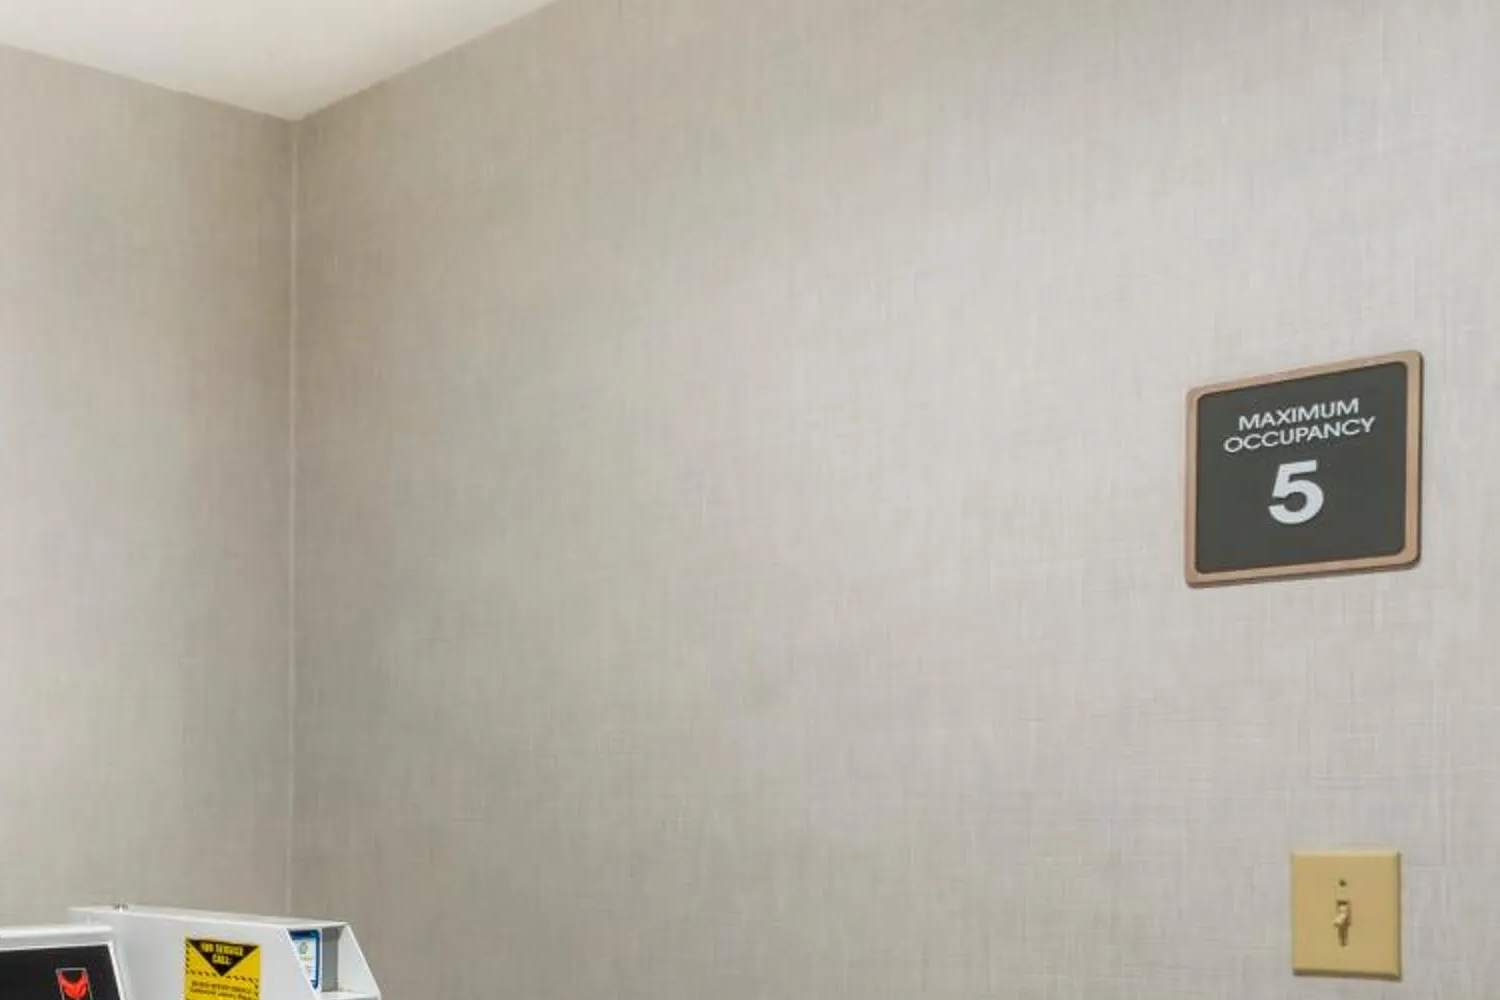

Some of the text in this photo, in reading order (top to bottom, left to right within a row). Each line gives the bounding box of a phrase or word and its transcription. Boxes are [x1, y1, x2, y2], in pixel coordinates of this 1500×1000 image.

[1238, 397, 1360, 431] MAXIMUM
[1223, 416, 1376, 453] OCCUPANCY
[1267, 459, 1325, 525] 5
